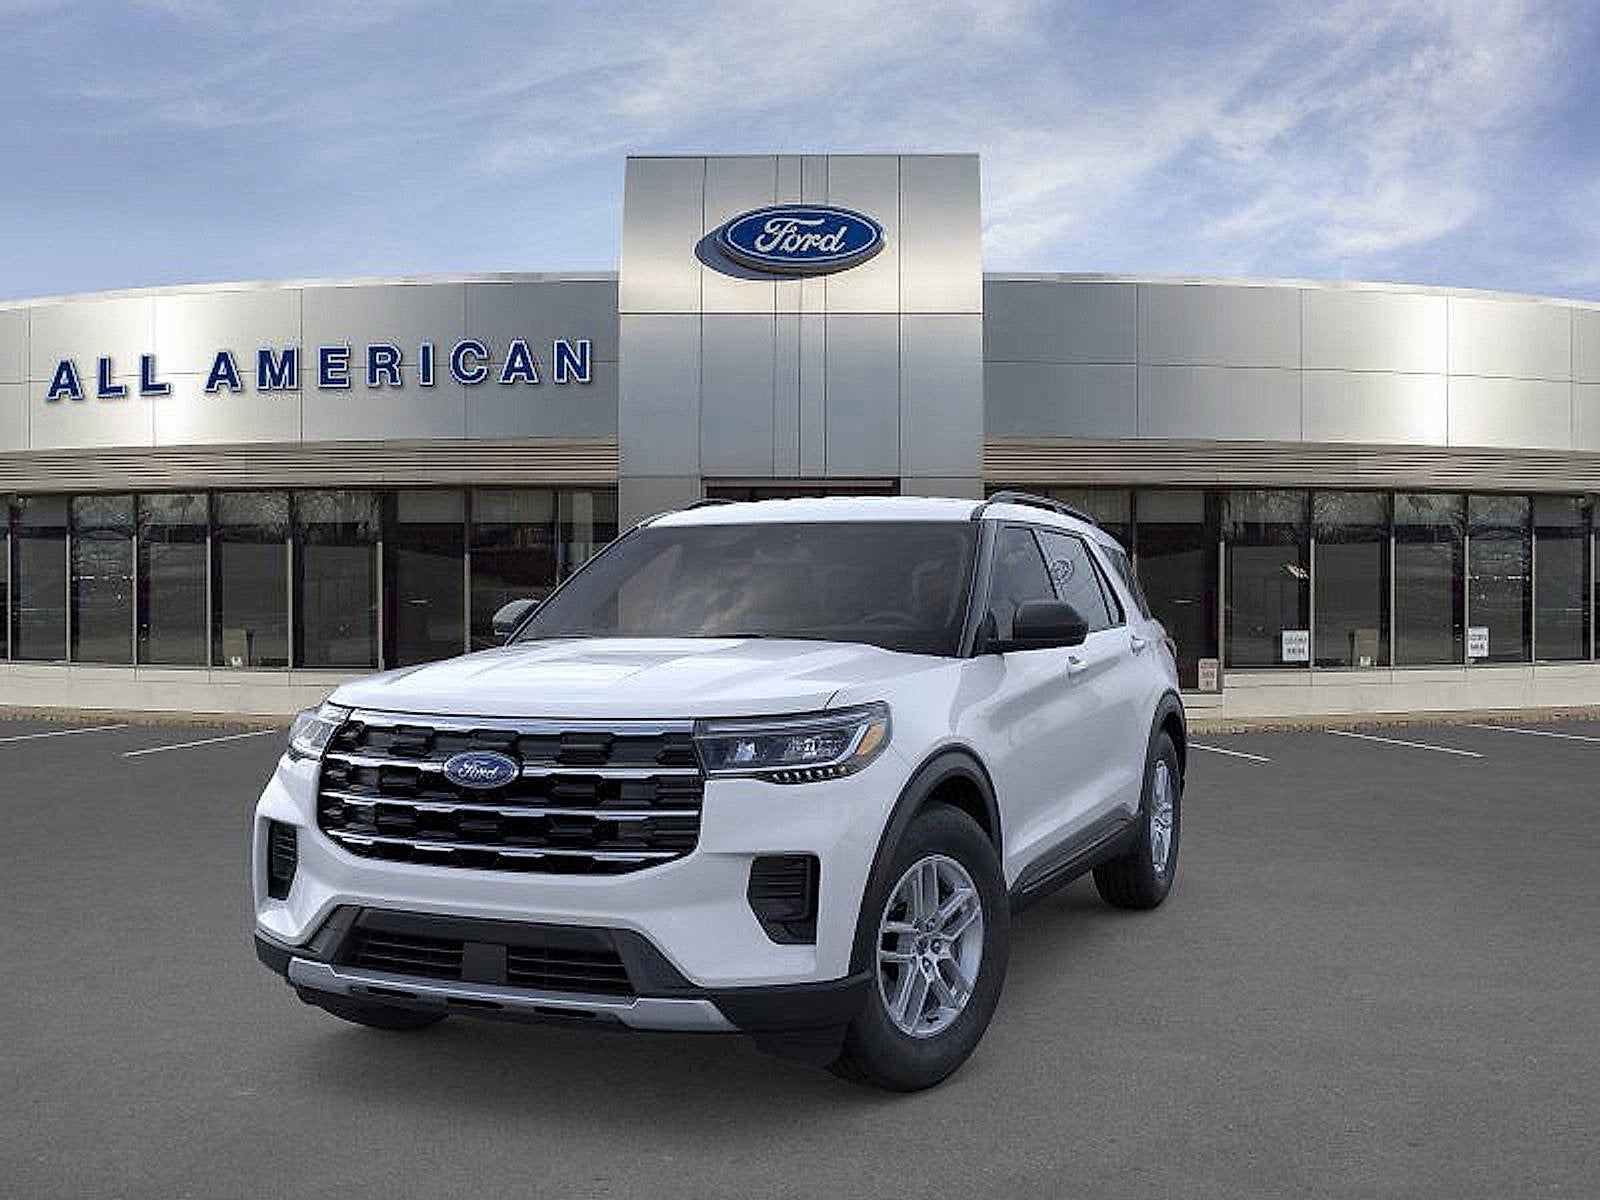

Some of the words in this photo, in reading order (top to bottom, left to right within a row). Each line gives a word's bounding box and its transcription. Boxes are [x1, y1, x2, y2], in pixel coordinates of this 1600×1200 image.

[755, 218, 848, 252] Ford
[47, 354, 171, 401] ALL
[205, 339, 592, 393] AMERICAN
[458, 760, 500, 779] Ford
